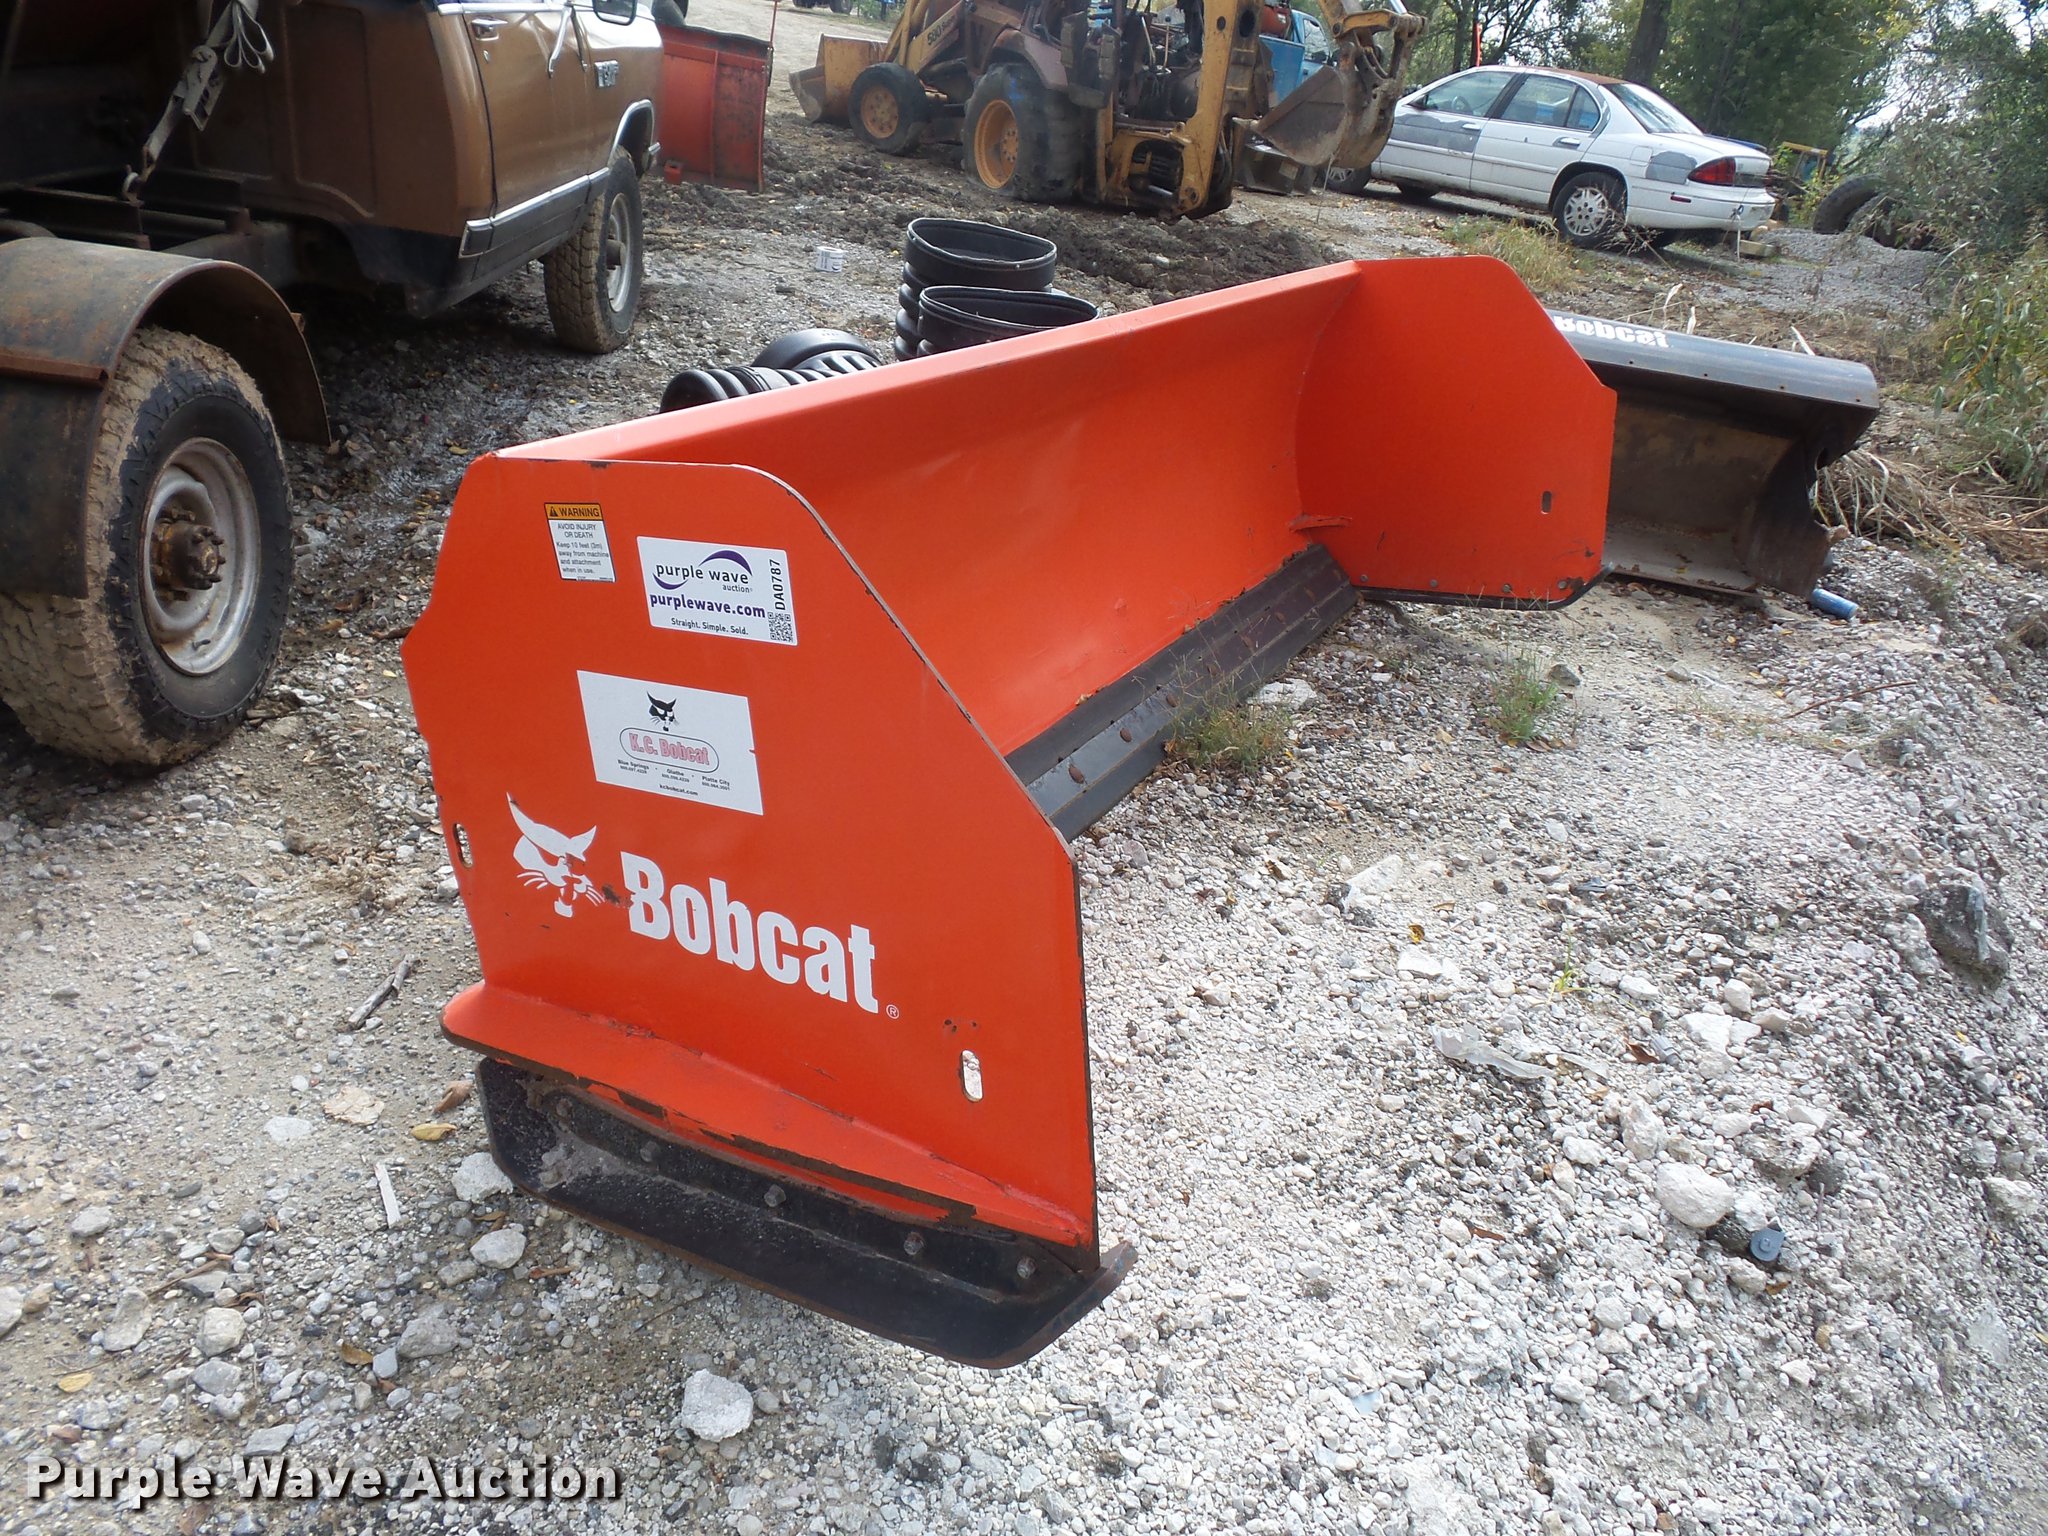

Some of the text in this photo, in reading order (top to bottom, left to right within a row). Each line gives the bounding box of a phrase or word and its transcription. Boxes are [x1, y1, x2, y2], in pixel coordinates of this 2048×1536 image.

[559, 507, 600, 517] WARNING
[576, 523, 596, 531] INJURY
[656, 564, 749, 584] purple wave
[768, 558, 786, 611] DA0787
[650, 593, 766, 618] purplewave.com
[670, 617, 749, 636] Straight. Simple. Sold.
[628, 732, 710, 766] K.C. Bobcat
[620, 850, 879, 1014] Bobcat
